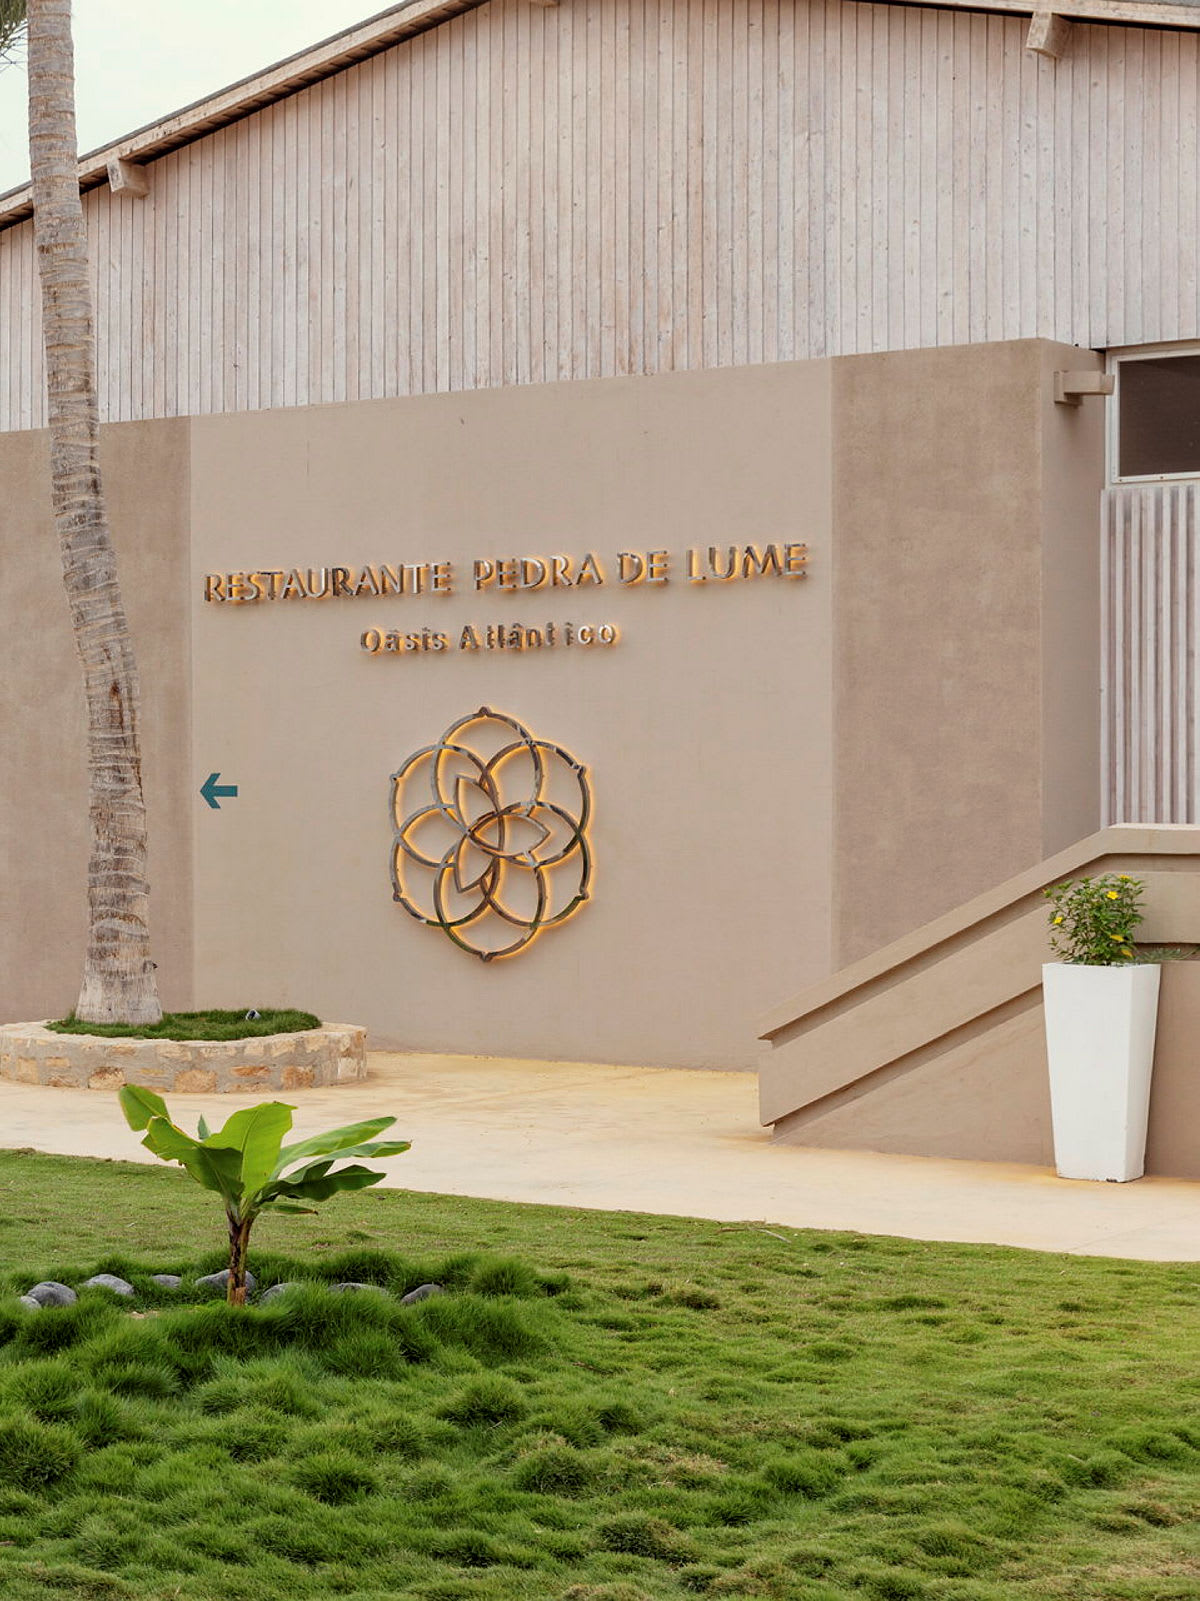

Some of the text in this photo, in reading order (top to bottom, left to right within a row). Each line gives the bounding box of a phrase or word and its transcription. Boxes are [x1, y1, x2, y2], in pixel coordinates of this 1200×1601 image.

[204, 543, 806, 602] RESTAURANTE PEDRA DE LUME
